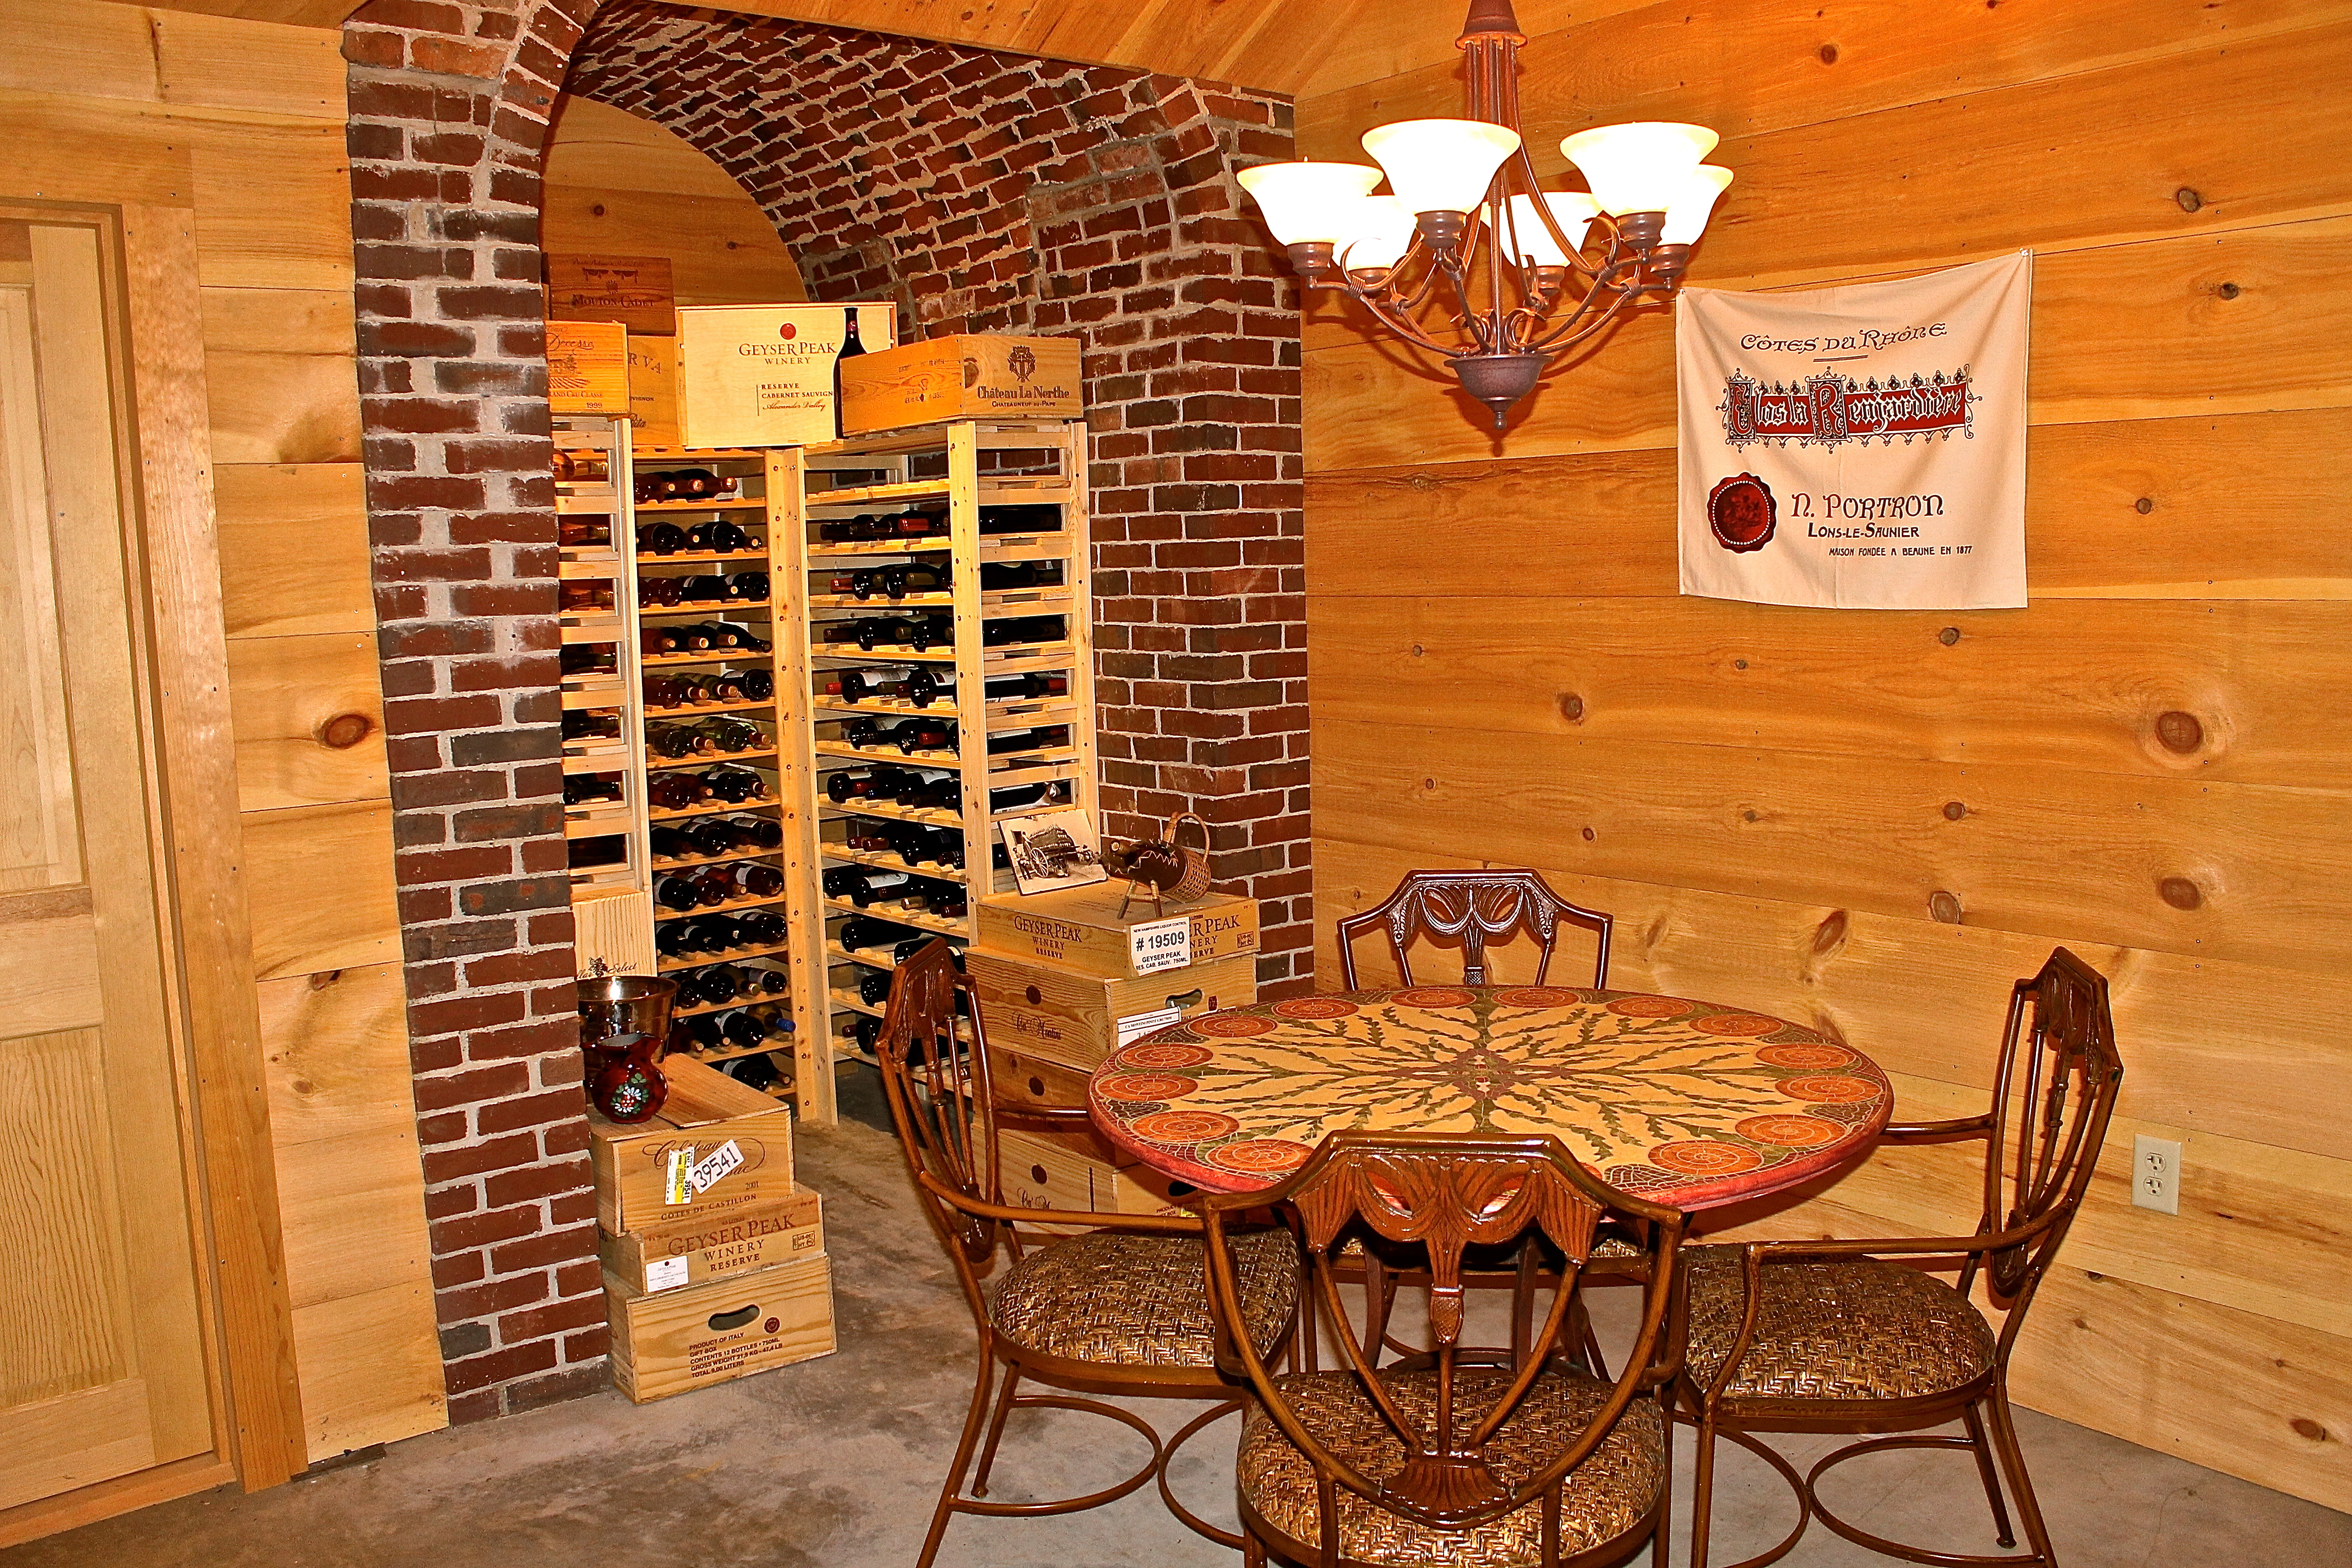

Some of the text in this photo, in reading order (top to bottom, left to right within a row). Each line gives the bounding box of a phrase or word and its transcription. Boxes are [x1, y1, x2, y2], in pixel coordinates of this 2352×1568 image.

[739, 342, 837, 356] GEYSER PEAK
[1019, 385, 1032, 399] La
[1033, 385, 1070, 399] Nerthe
[1791, 492, 1944, 521] N. PORTRON
[1807, 522, 1920, 538] LONS-LE-SAUNIER
[1828, 545, 1973, 557] MAISON FONDÉE A BEAUNE EN 1877
[1014, 916, 1083, 943] GEYSER PEAK
[1205, 914, 1241, 934] PEAK
[1032, 936, 1065, 950] WINERY
[1136, 931, 1185, 952] # 19509
[1035, 948, 1063, 960] RESERVE
[1142, 950, 1181, 963] GEYSER PEAK
[607, 961, 638, 974] Select
[694, 1147, 739, 1188] 39541
[683, 1180, 692, 1200] 39541
[709, 1194, 756, 1210] CASTILLON
[668, 1212, 796, 1256] GEYSER PEAK
[704, 1239, 765, 1262] WINERY
[710, 1253, 760, 1272] RESERVE
[689, 1338, 718, 1351] PRODUCT
[728, 1332, 744, 1341] ITALY
[690, 1352, 722, 1364] CONTENTS
[731, 1342, 758, 1354] BOTTLES
[690, 1362, 714, 1371] GROSS
[713, 1355, 736, 1365] WEIGHT
[692, 1369, 710, 1378] TOTAL
[723, 1360, 745, 1370] LITERS
